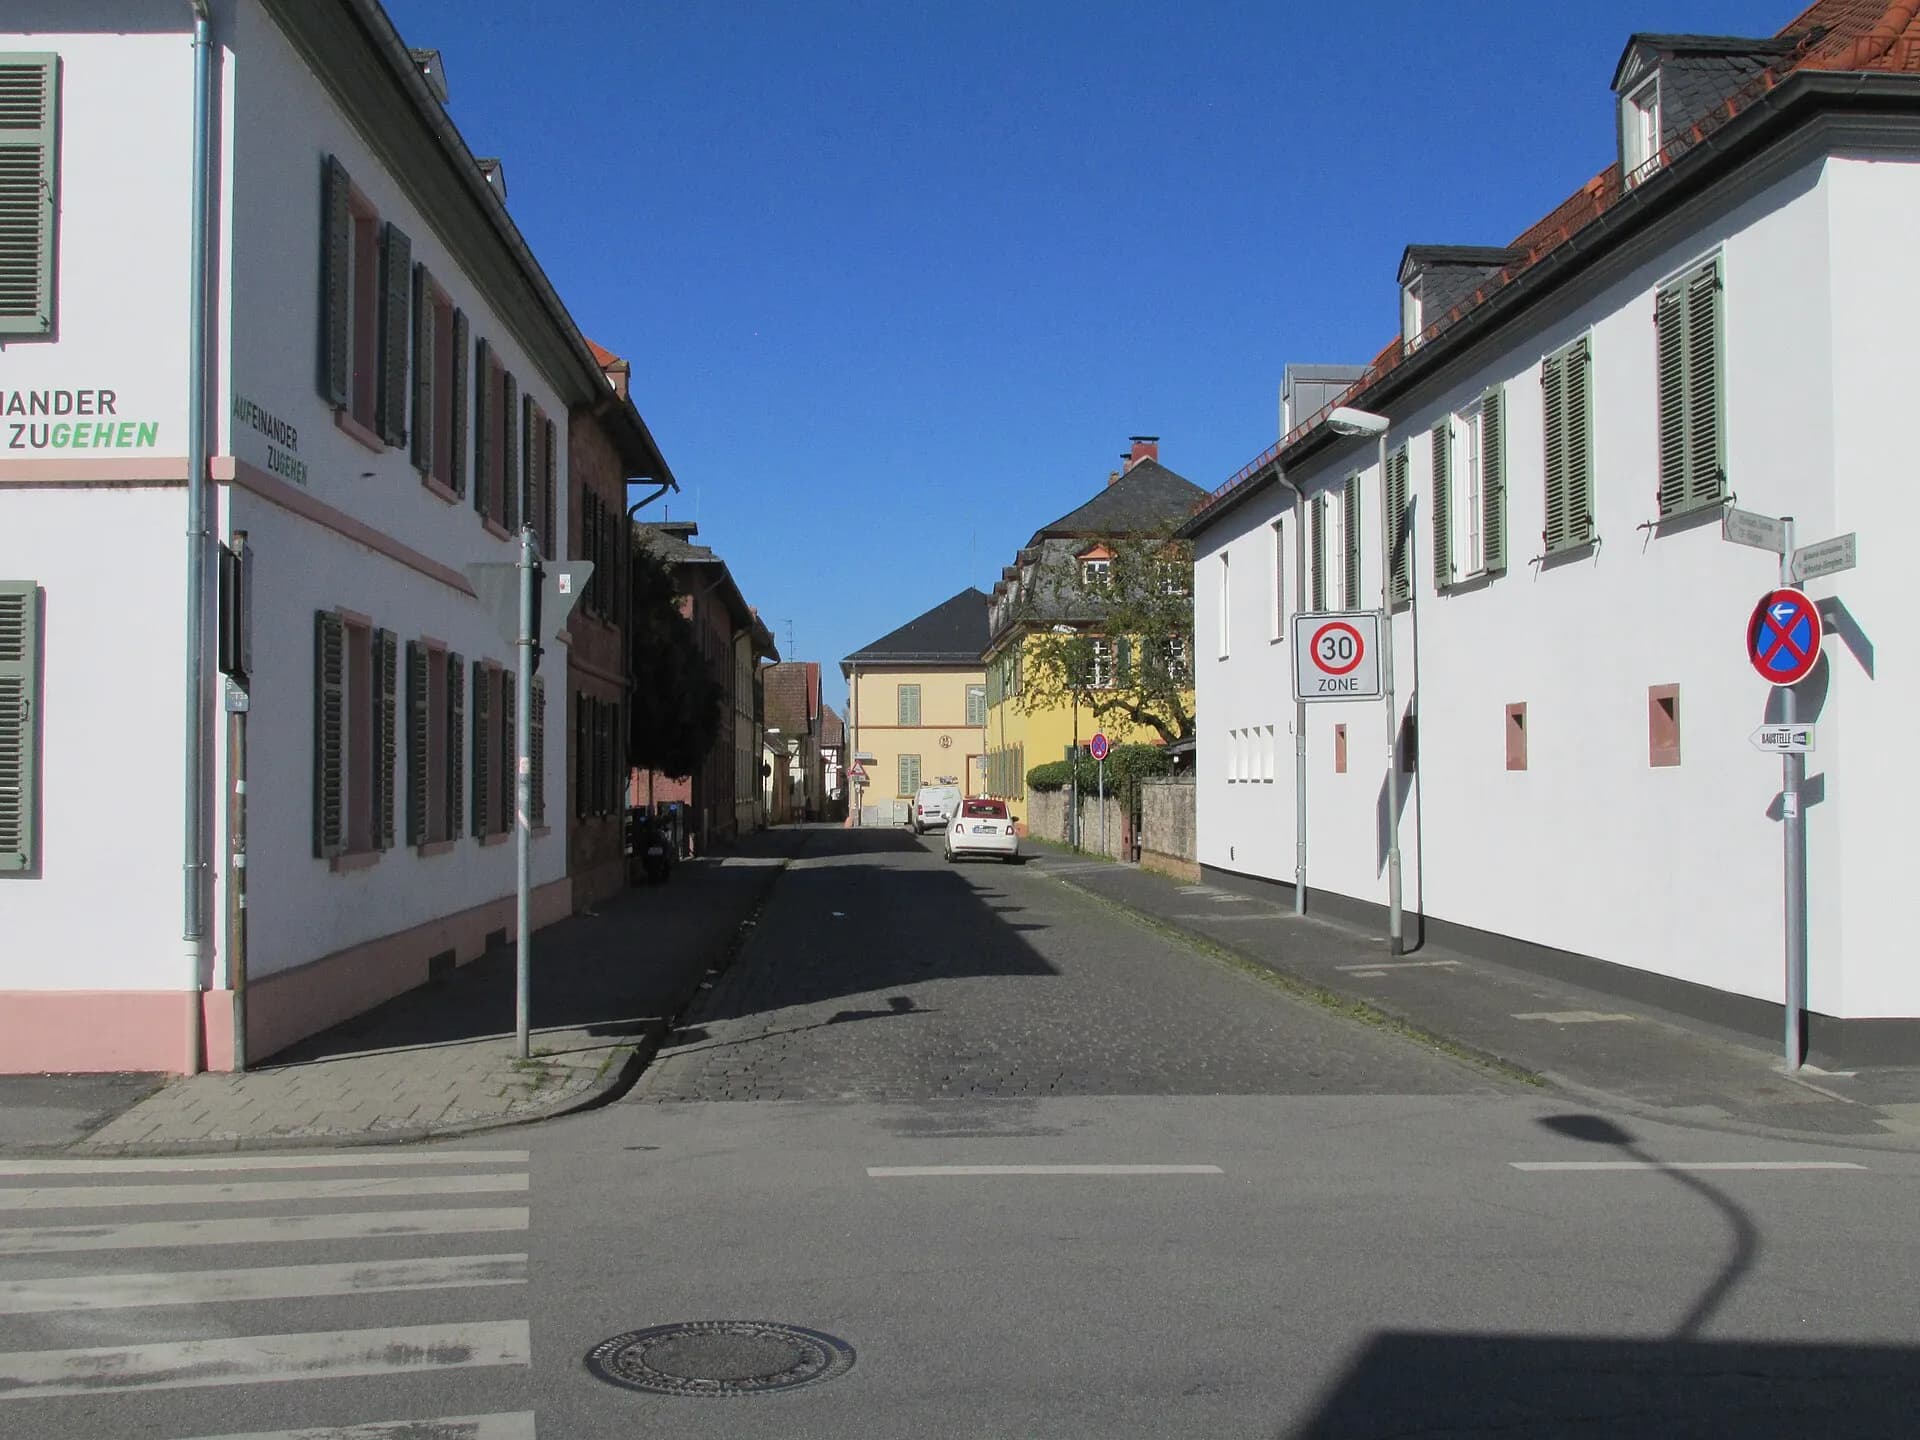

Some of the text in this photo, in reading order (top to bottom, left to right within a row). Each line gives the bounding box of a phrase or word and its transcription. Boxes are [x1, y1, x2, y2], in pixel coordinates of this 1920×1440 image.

[0, 389, 117, 416] ANDER
[9, 421, 160, 449] ZUGEHEN
[234, 391, 298, 453] AUFEINANDER
[267, 444, 309, 487] ZUGEHEN
[1322, 636, 1353, 660] 30
[1318, 678, 1359, 691] ZONE
[1761, 732, 1791, 744] BAUSTELLE
